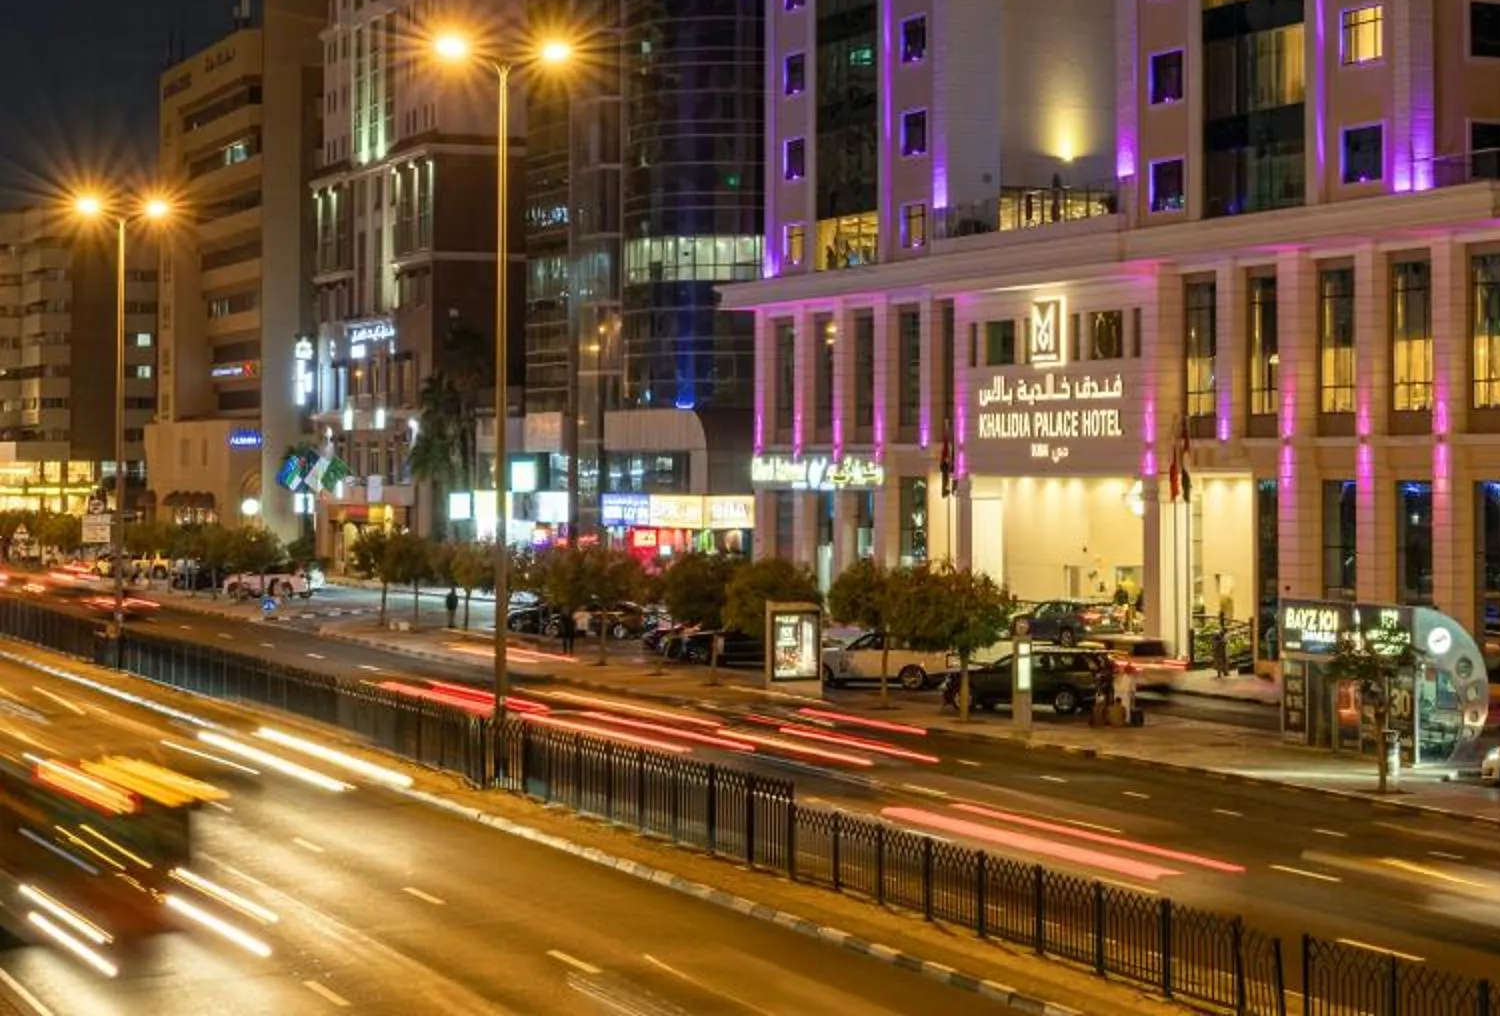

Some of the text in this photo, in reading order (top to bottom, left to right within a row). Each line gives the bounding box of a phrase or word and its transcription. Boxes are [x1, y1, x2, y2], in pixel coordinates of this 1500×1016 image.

[1074, 374, 1123, 400] فندق
[978, 409, 1123, 438] KHALIDIA PALACE HOTEL
[1285, 607, 1318, 631] BAYZ
